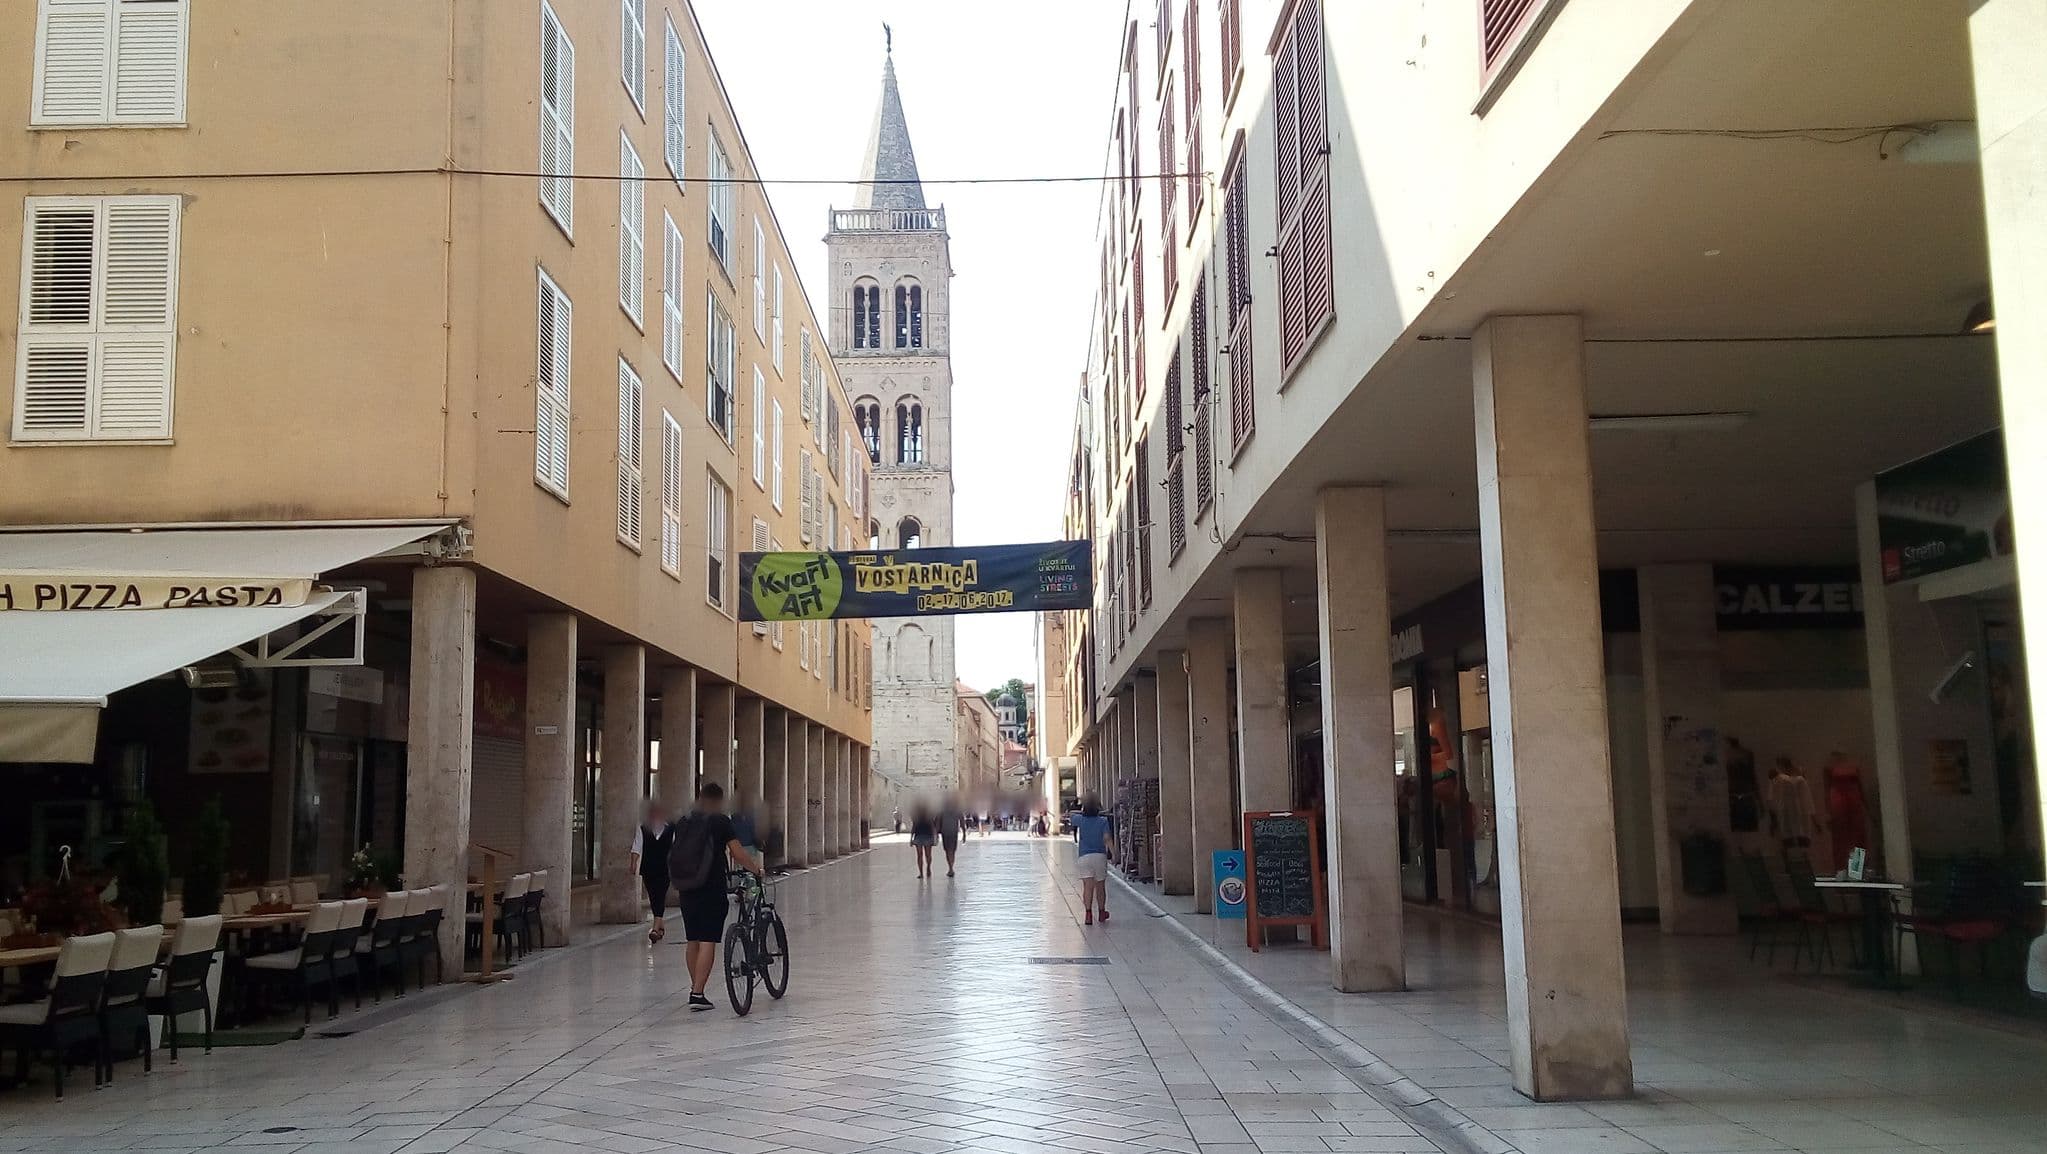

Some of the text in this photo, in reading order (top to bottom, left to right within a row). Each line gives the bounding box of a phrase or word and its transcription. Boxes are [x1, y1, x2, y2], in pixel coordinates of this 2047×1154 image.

[758, 555, 829, 597] Kvart
[1039, 574, 1072, 583] LIVING
[1040, 583, 1078, 592] STREETS
[35, 584, 142, 610] PIZZA
[164, 586, 282, 608] PASTA
[779, 585, 823, 617] Art
